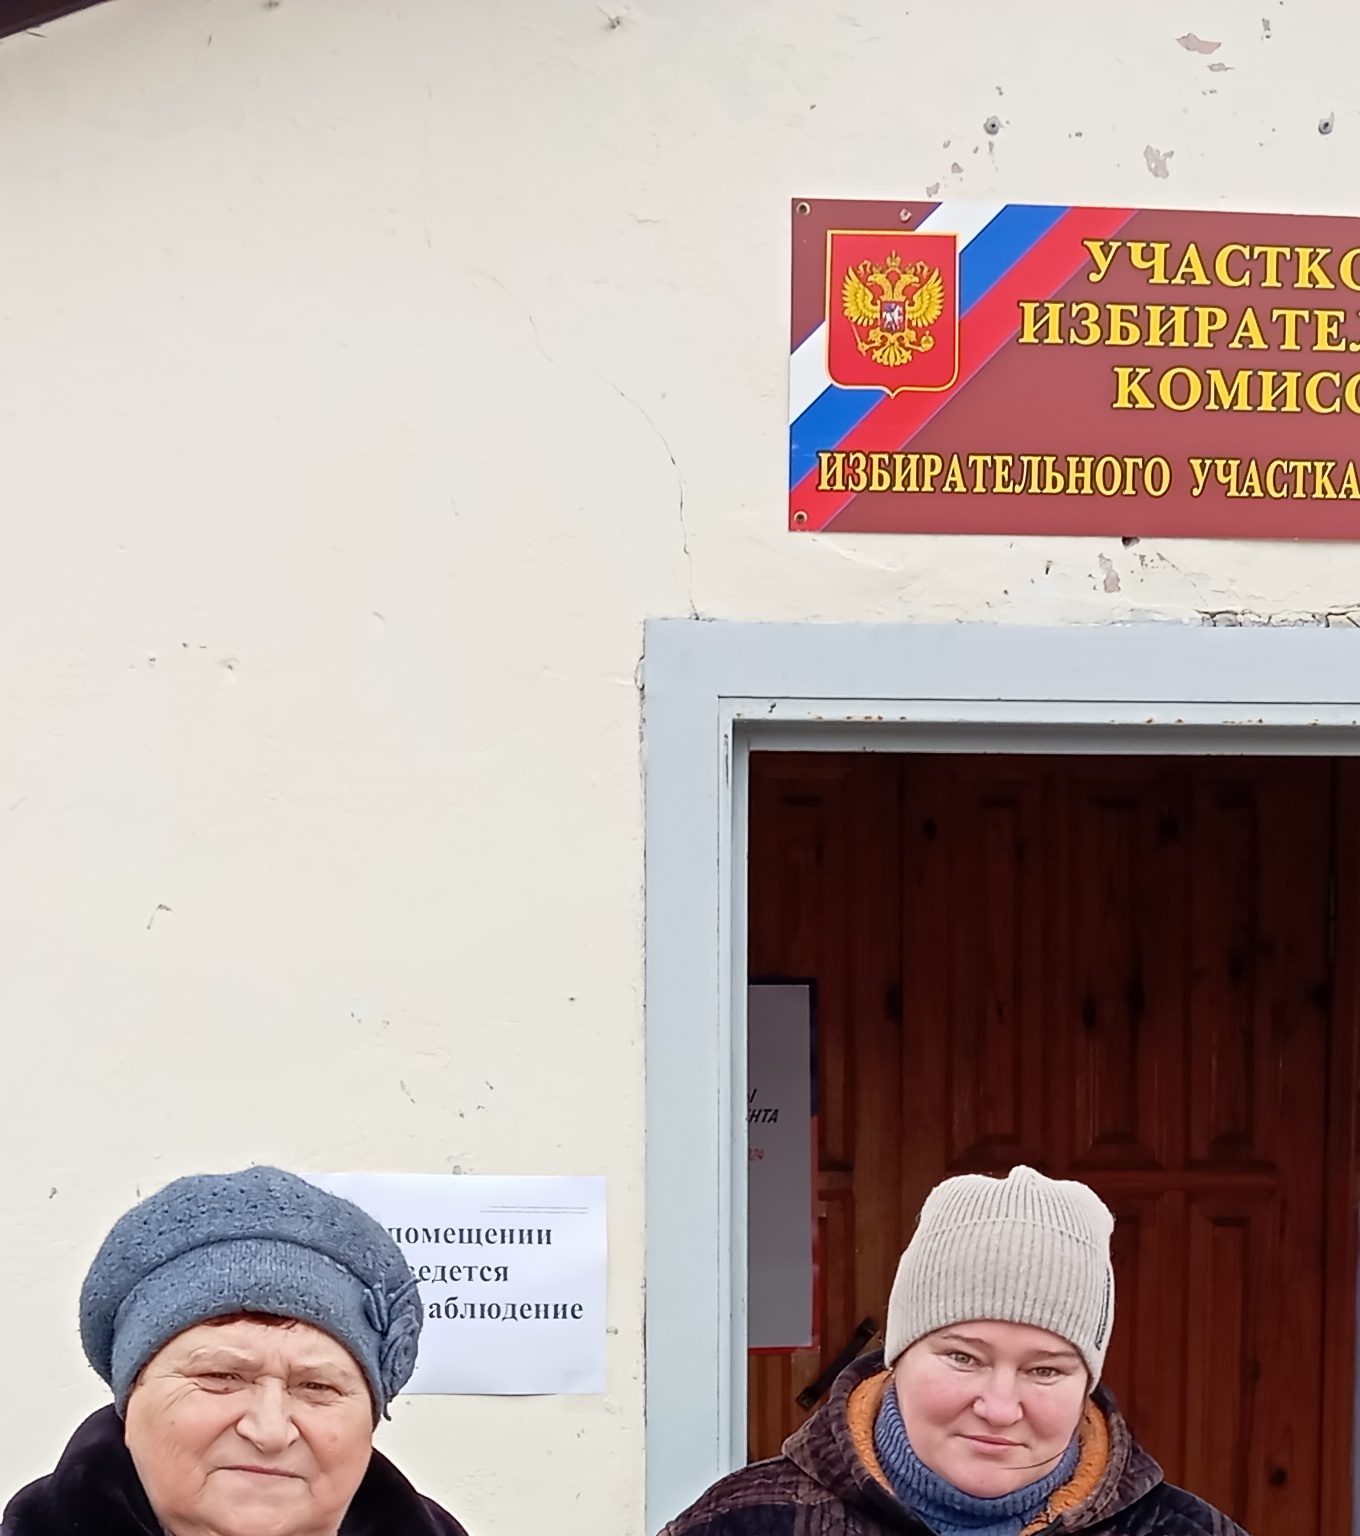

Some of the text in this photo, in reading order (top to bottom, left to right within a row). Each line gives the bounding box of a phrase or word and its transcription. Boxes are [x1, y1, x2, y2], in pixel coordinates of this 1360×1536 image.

[817, 451, 1170, 498] ИЗБИРАТЕЛЬНОГО
[387, 1226, 552, 1246] помещении
[421, 1296, 584, 1322] аблюдение
